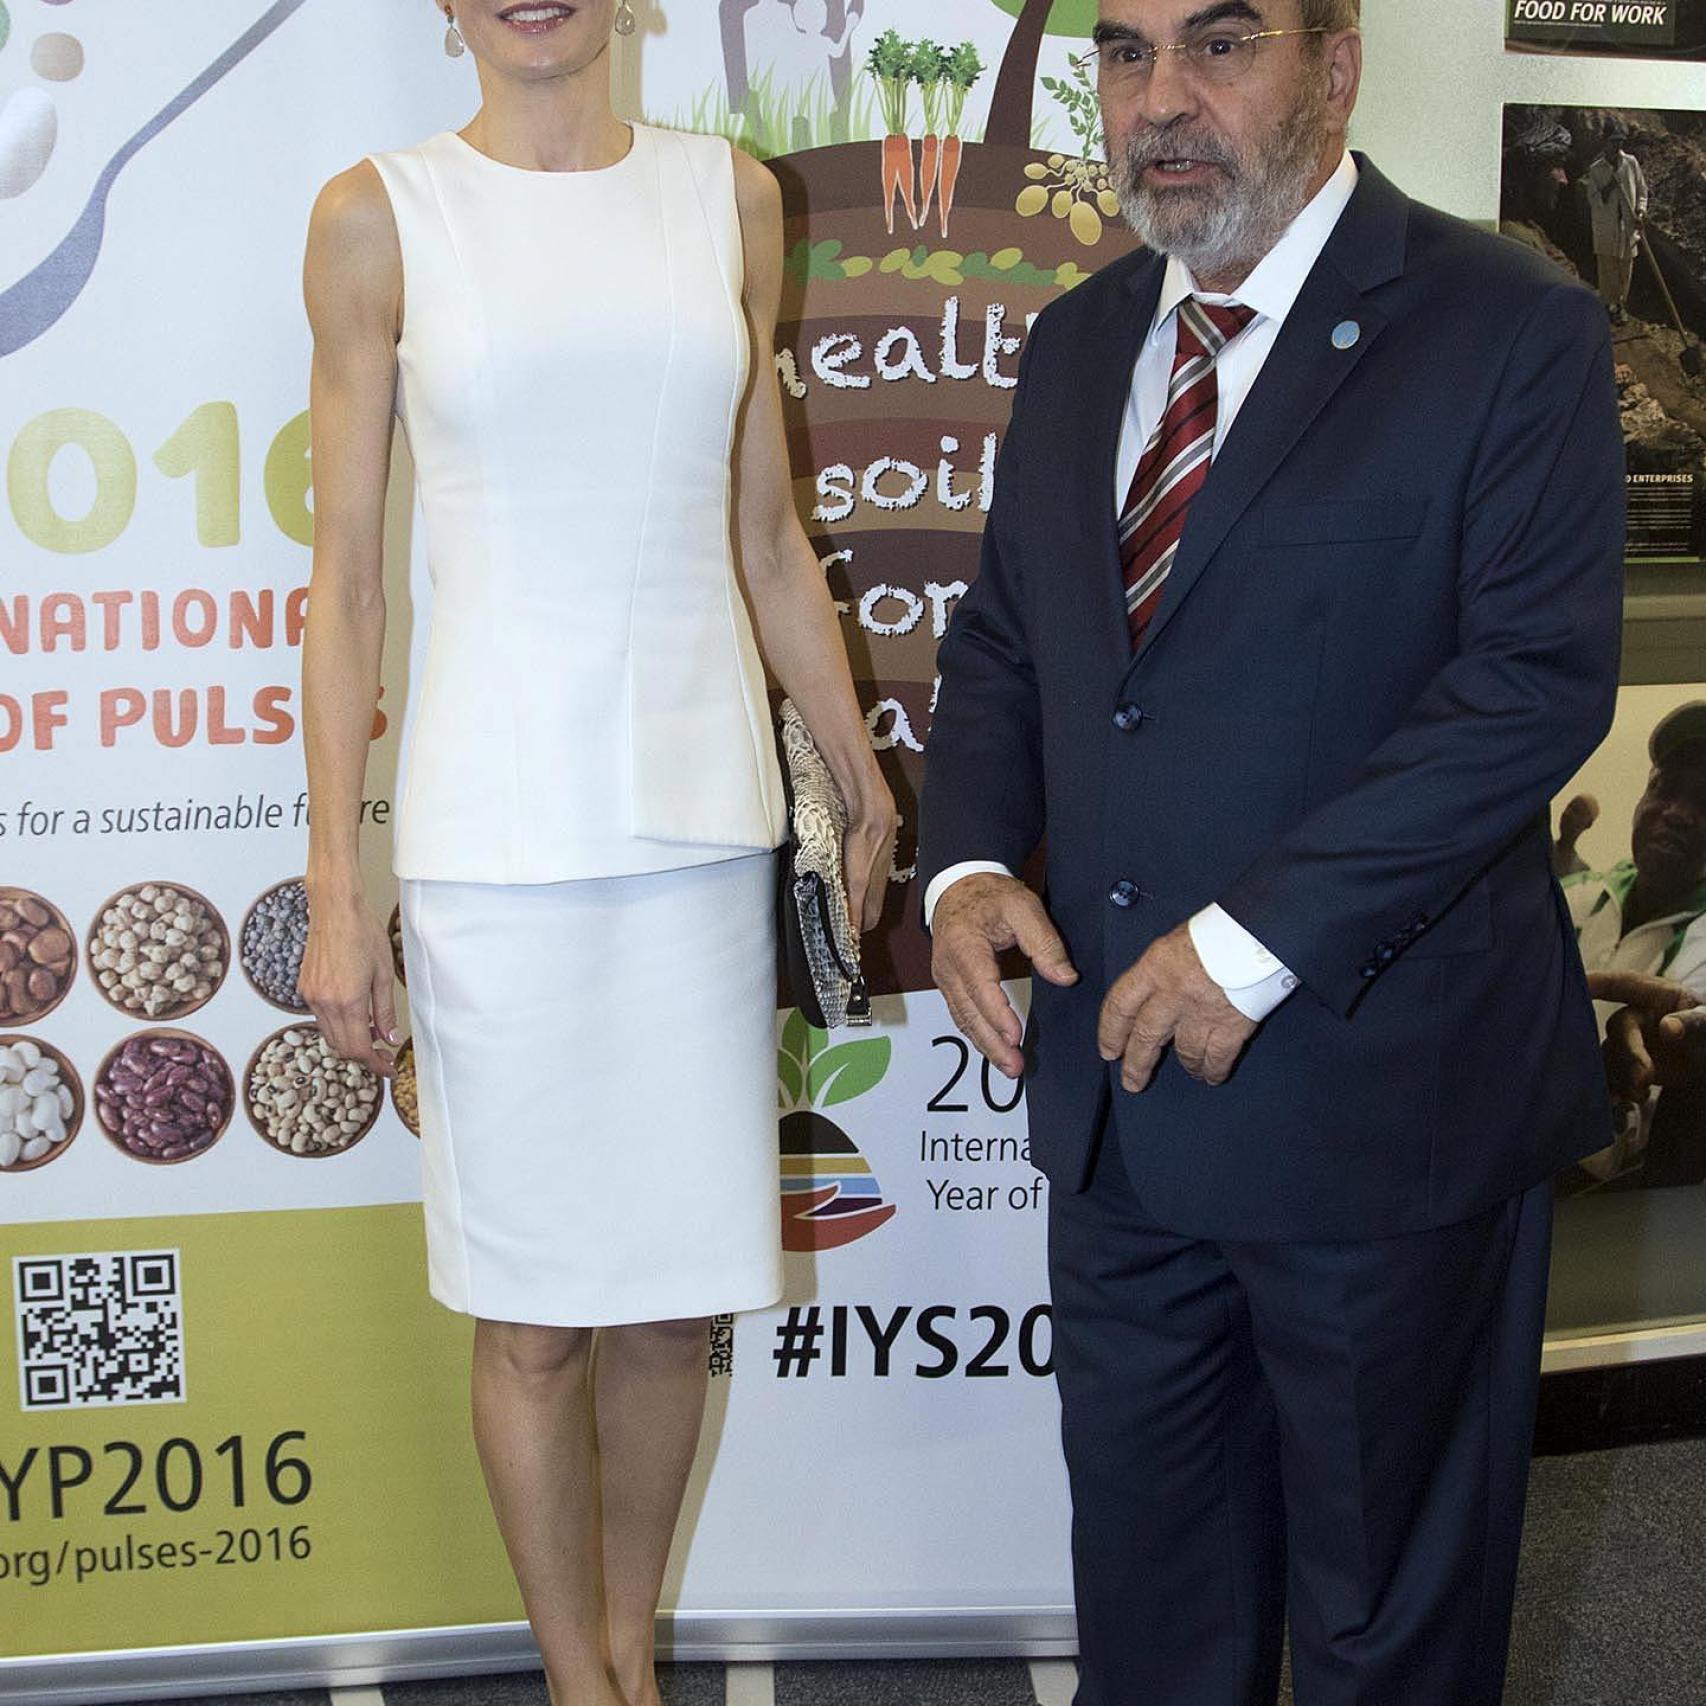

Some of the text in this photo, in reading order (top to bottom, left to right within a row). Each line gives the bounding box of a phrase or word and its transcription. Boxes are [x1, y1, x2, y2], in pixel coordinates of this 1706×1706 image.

[1514, 0, 1667, 25] FOOD FOR WORK
[776, 296, 1039, 398] ealt
[1633, 474, 1694, 483] ENTERPRISES
[100, 686, 388, 749] PULS
[18, 801, 65, 836] for
[73, 811, 90, 834] a
[100, 795, 283, 833] sustainable
[926, 1177, 1043, 1211] Year of
[773, 1304, 1056, 1378] #IYS20
[0, 1430, 312, 1521] YP2016
